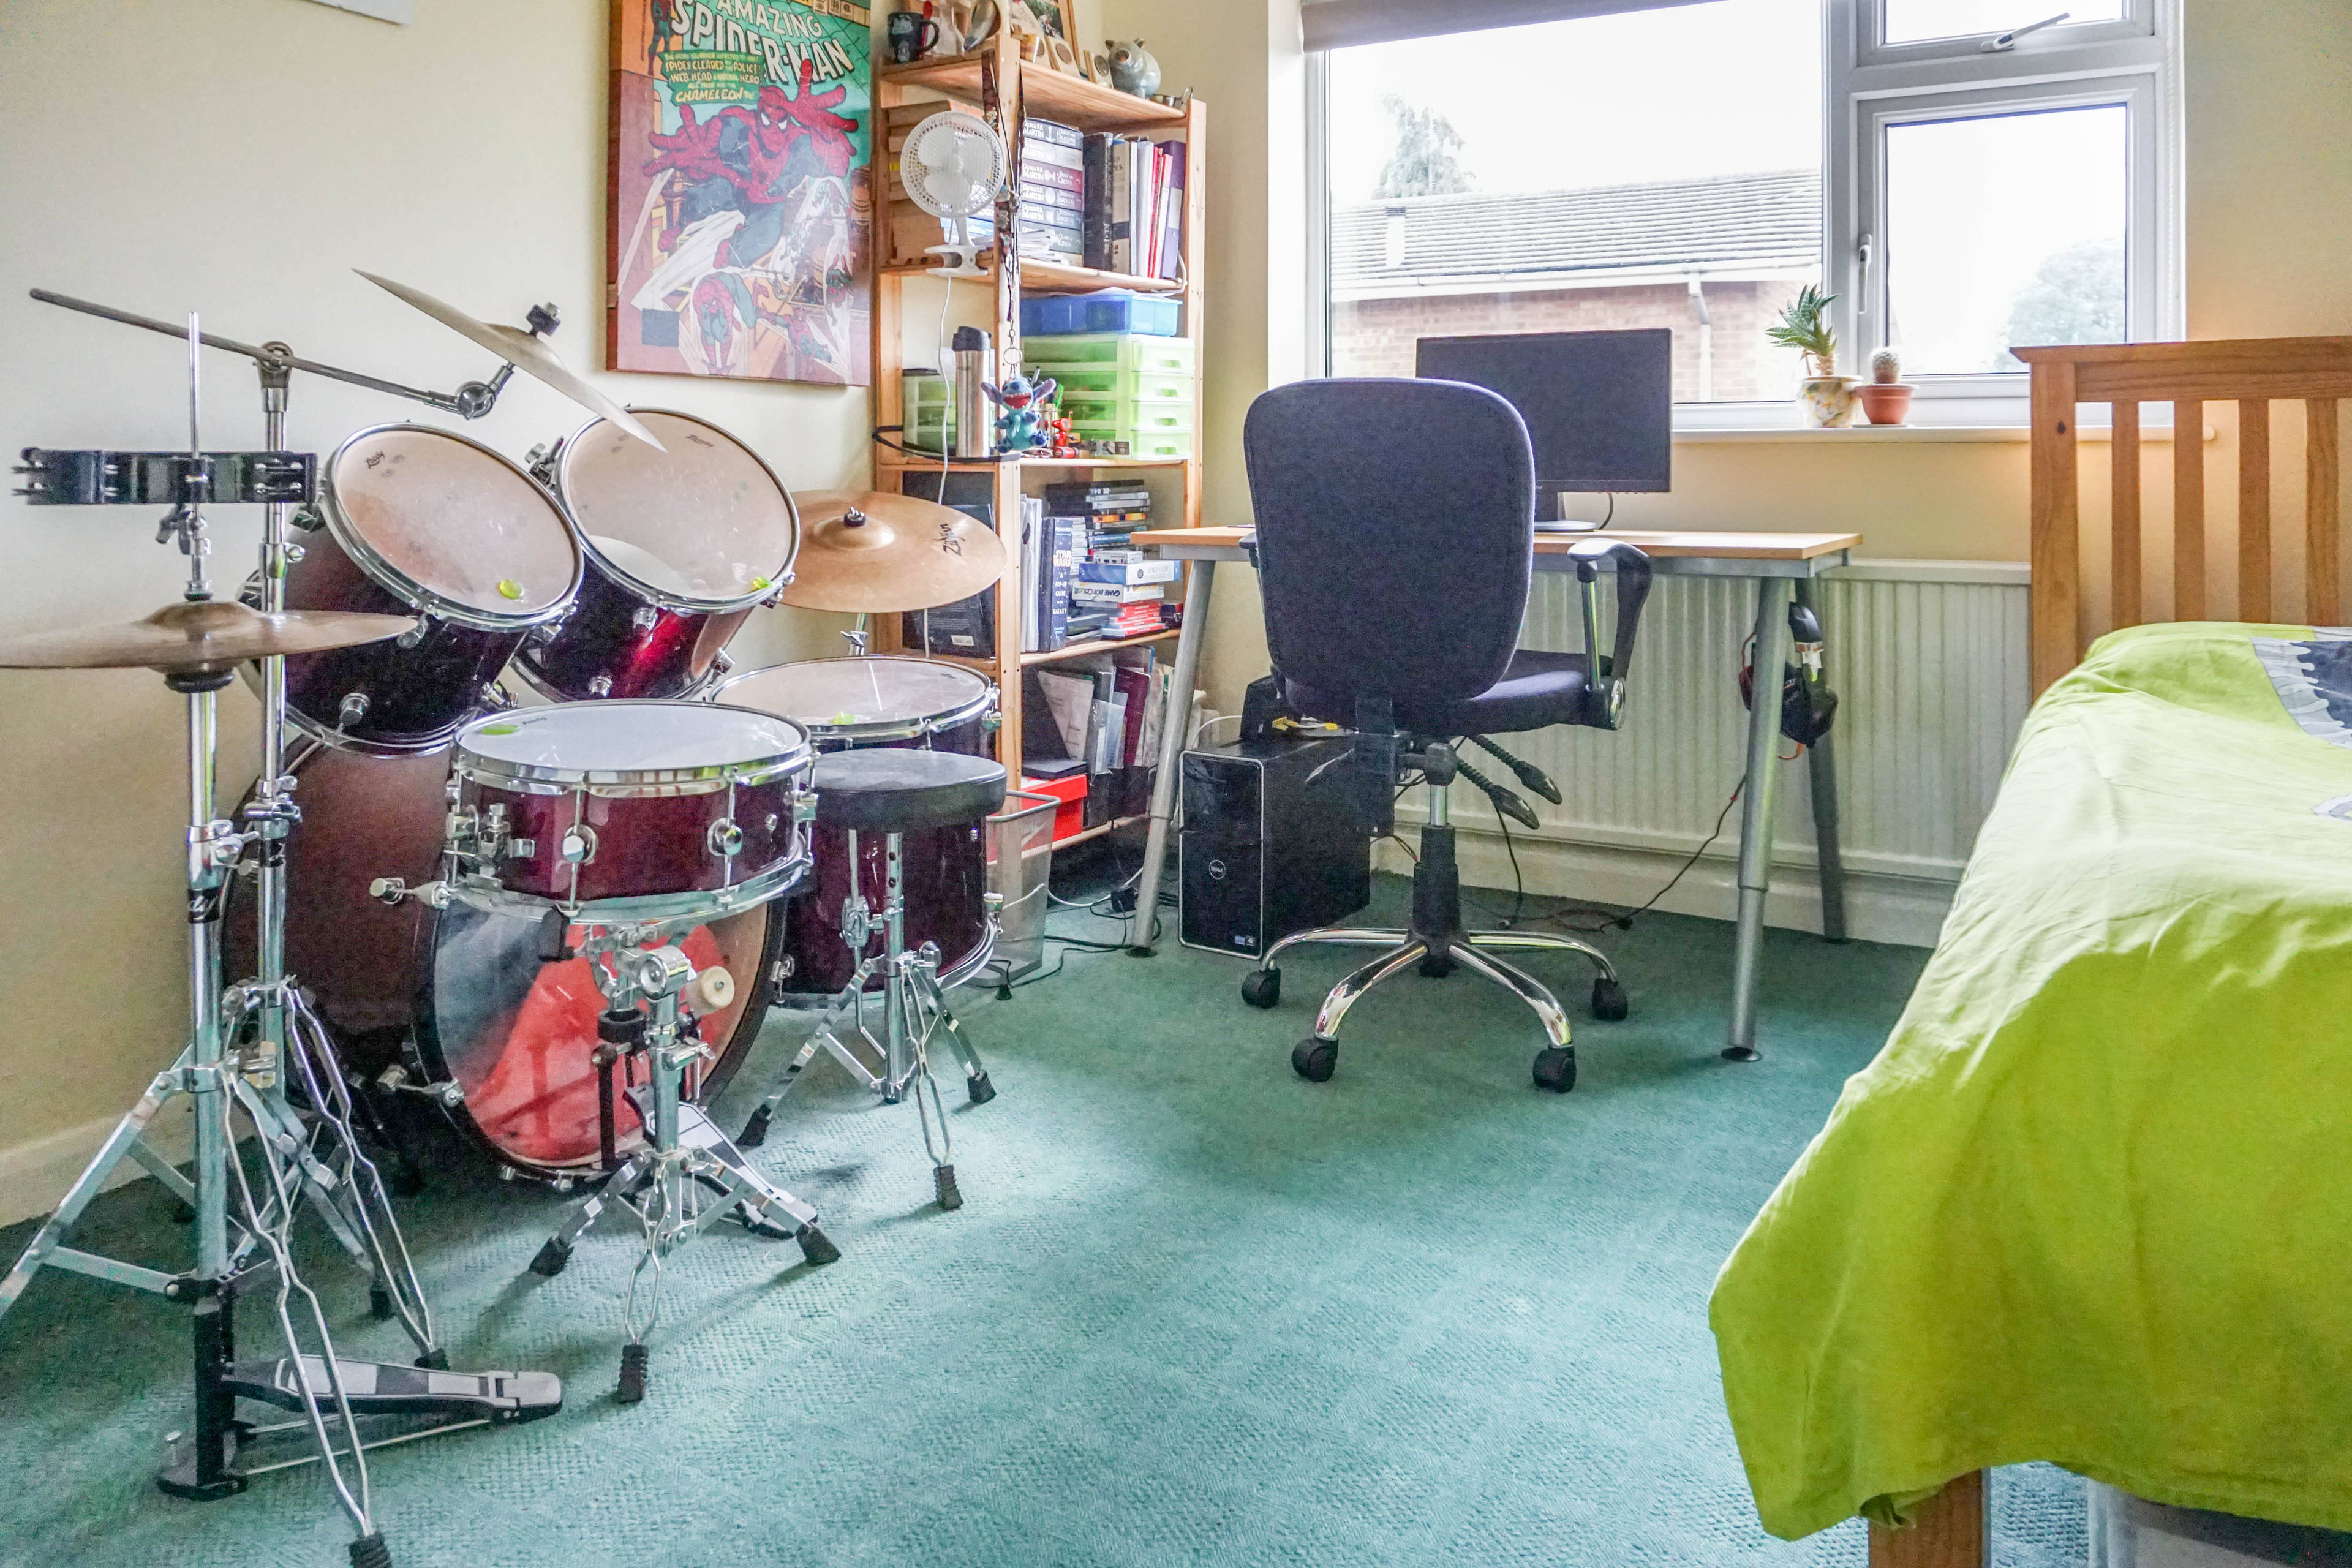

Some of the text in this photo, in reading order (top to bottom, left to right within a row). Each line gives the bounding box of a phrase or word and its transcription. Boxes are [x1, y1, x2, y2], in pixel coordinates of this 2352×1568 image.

[715, 0, 823, 38] AMAZING
[692, 60, 725, 70] CLEARED
[670, 72, 689, 83] WEB
[675, 86, 744, 103] CHAMELEON
[1074, 587, 1093, 595] COLOR
